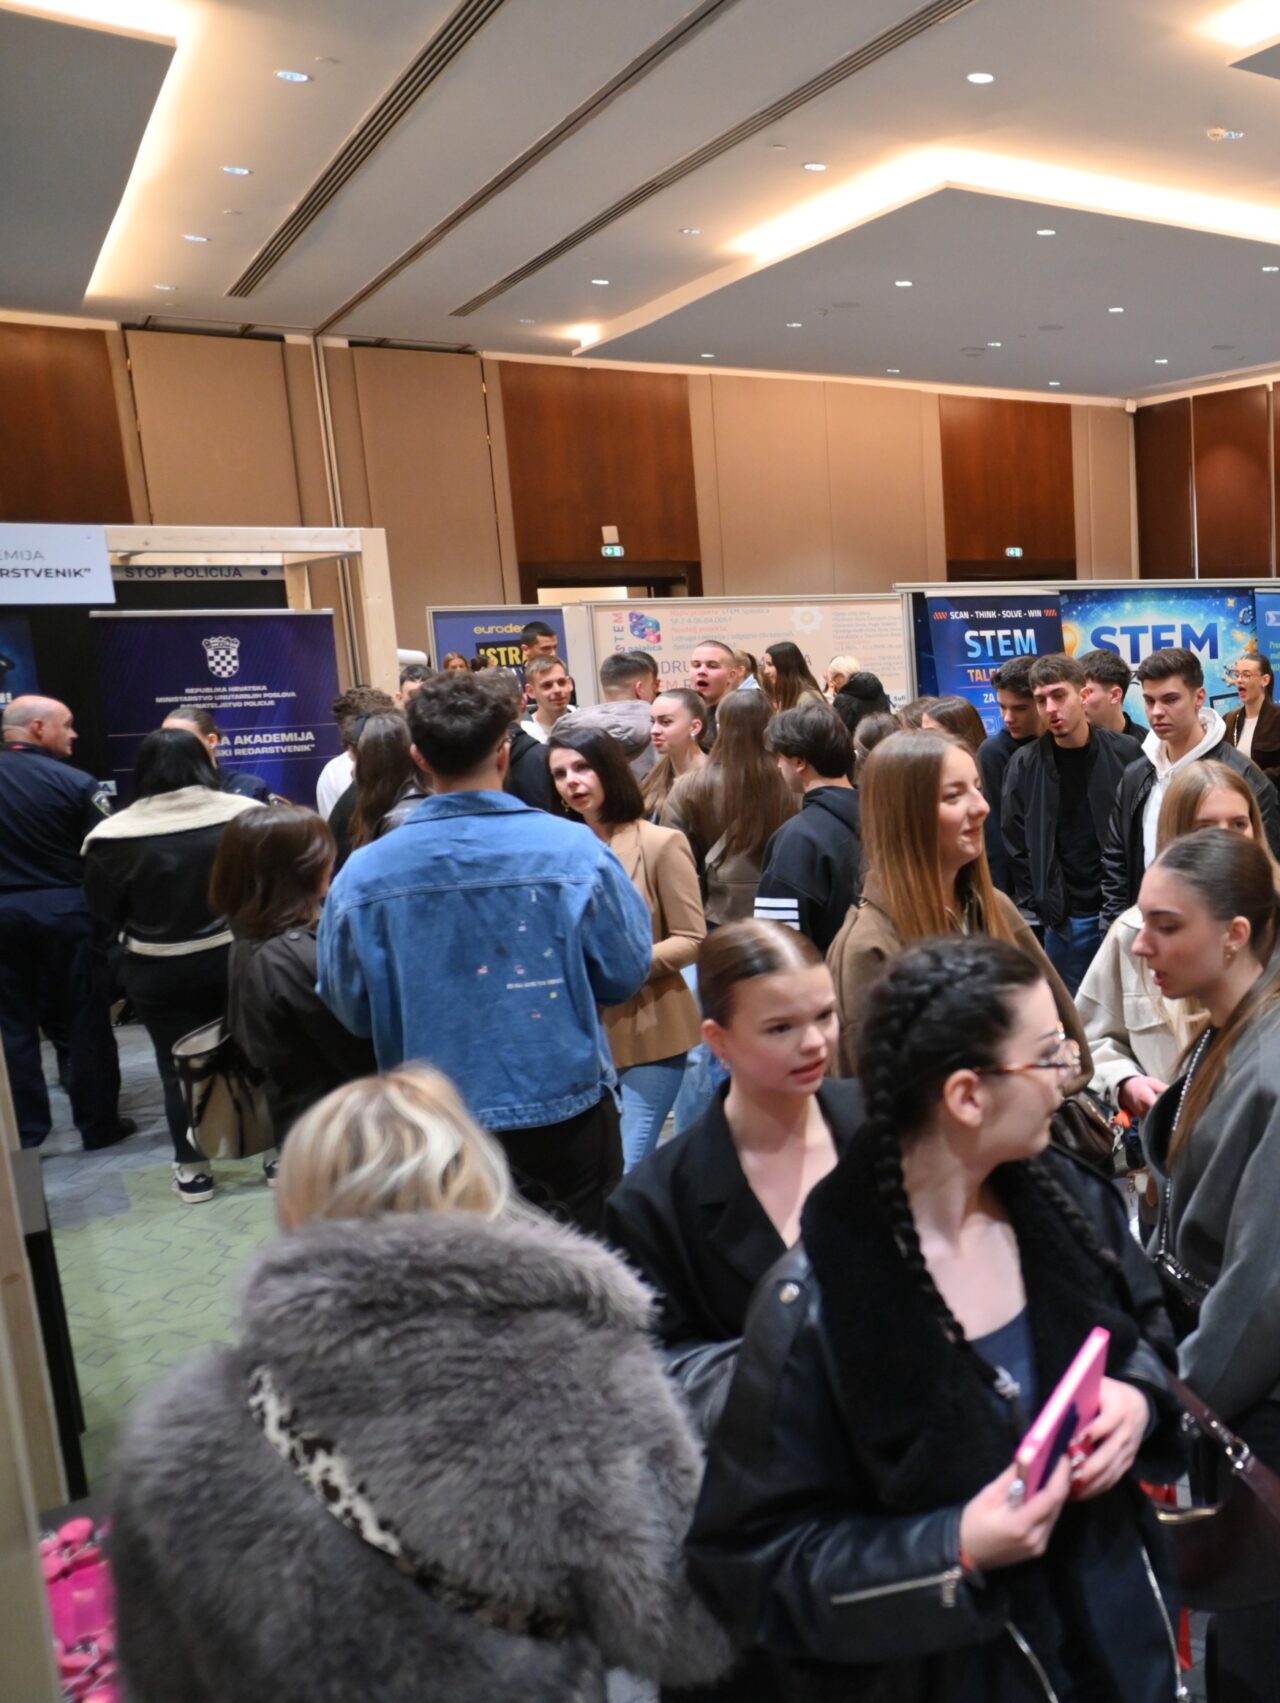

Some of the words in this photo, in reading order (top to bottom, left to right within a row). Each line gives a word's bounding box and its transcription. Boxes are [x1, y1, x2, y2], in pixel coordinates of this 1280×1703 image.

[124, 567, 167, 578] STOP
[173, 566, 242, 578] POLICIJA
[950, 611, 969, 620] SCAN
[975, 610, 997, 619] THINK
[1001, 609, 1022, 618] SOLVE
[1027, 609, 1042, 618] WIN
[964, 628, 1038, 658] STEM
[1090, 623, 1219, 664] STEM
[155, 695, 213, 703] MINISTARSTVO
[983, 693, 996, 703] ZA
[234, 731, 315, 746] AKADEMIJA
